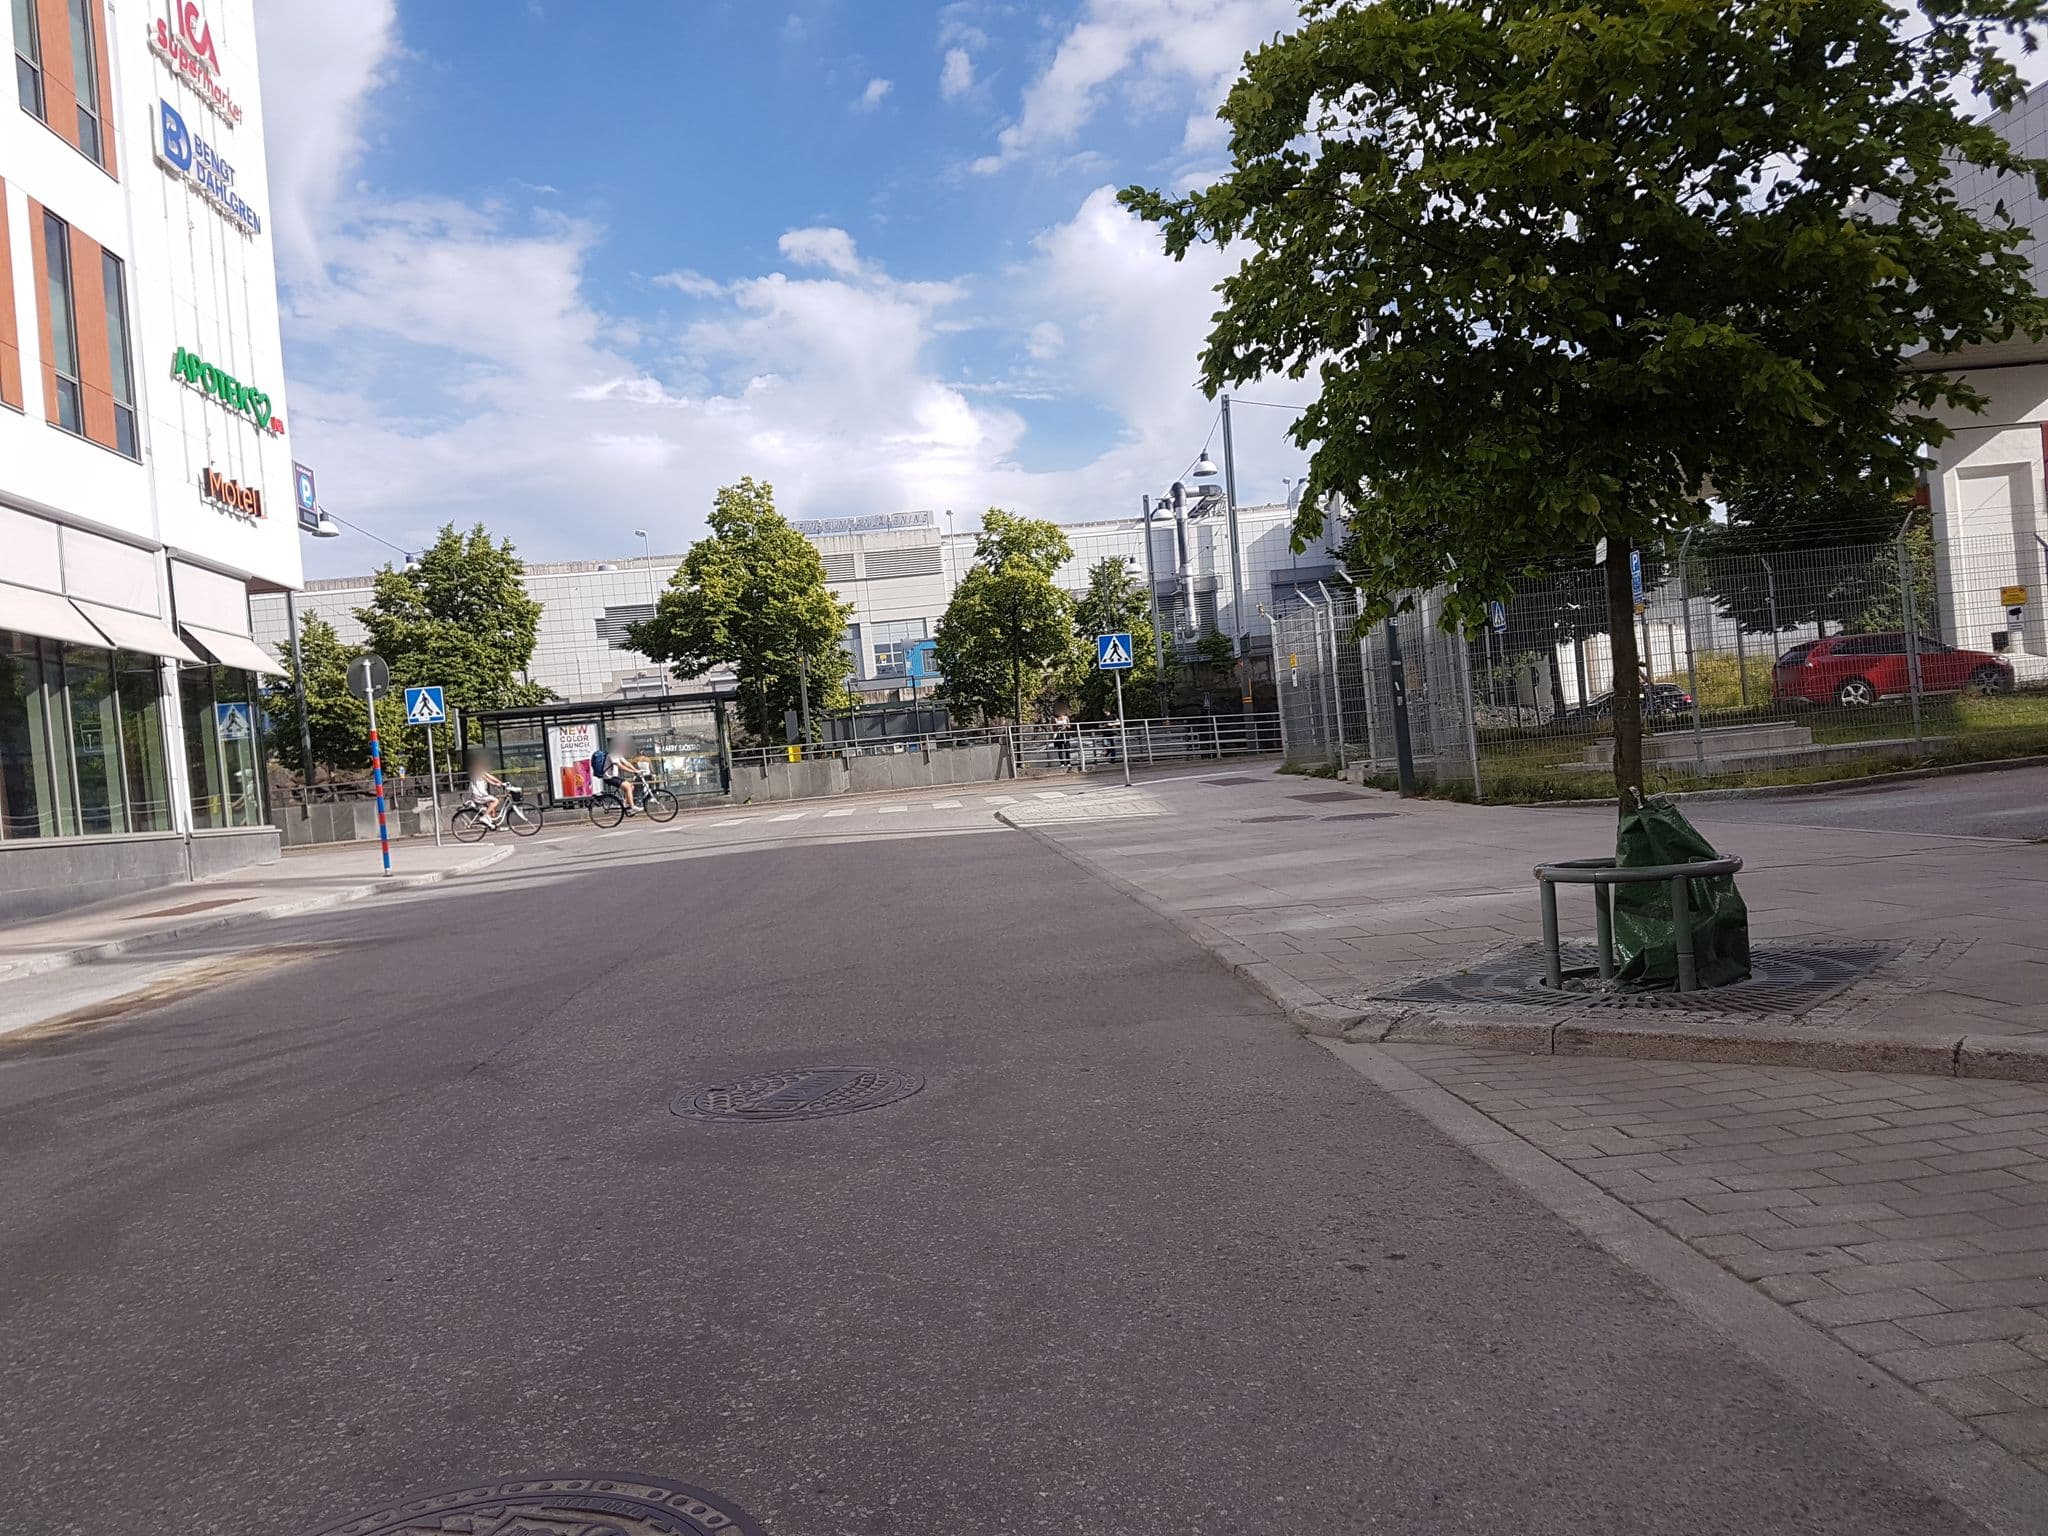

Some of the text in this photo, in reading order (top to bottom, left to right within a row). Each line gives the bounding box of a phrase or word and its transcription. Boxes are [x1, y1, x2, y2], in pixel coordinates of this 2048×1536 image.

[176, 0, 221, 76] ICA
[157, 17, 242, 125] Supermarket
[194, 133, 236, 187] BENGT
[196, 160, 262, 235] DAHLGREN
[208, 468, 258, 517] Motel
[559, 725, 588, 736] NEW
[560, 735, 589, 743] COLOR
